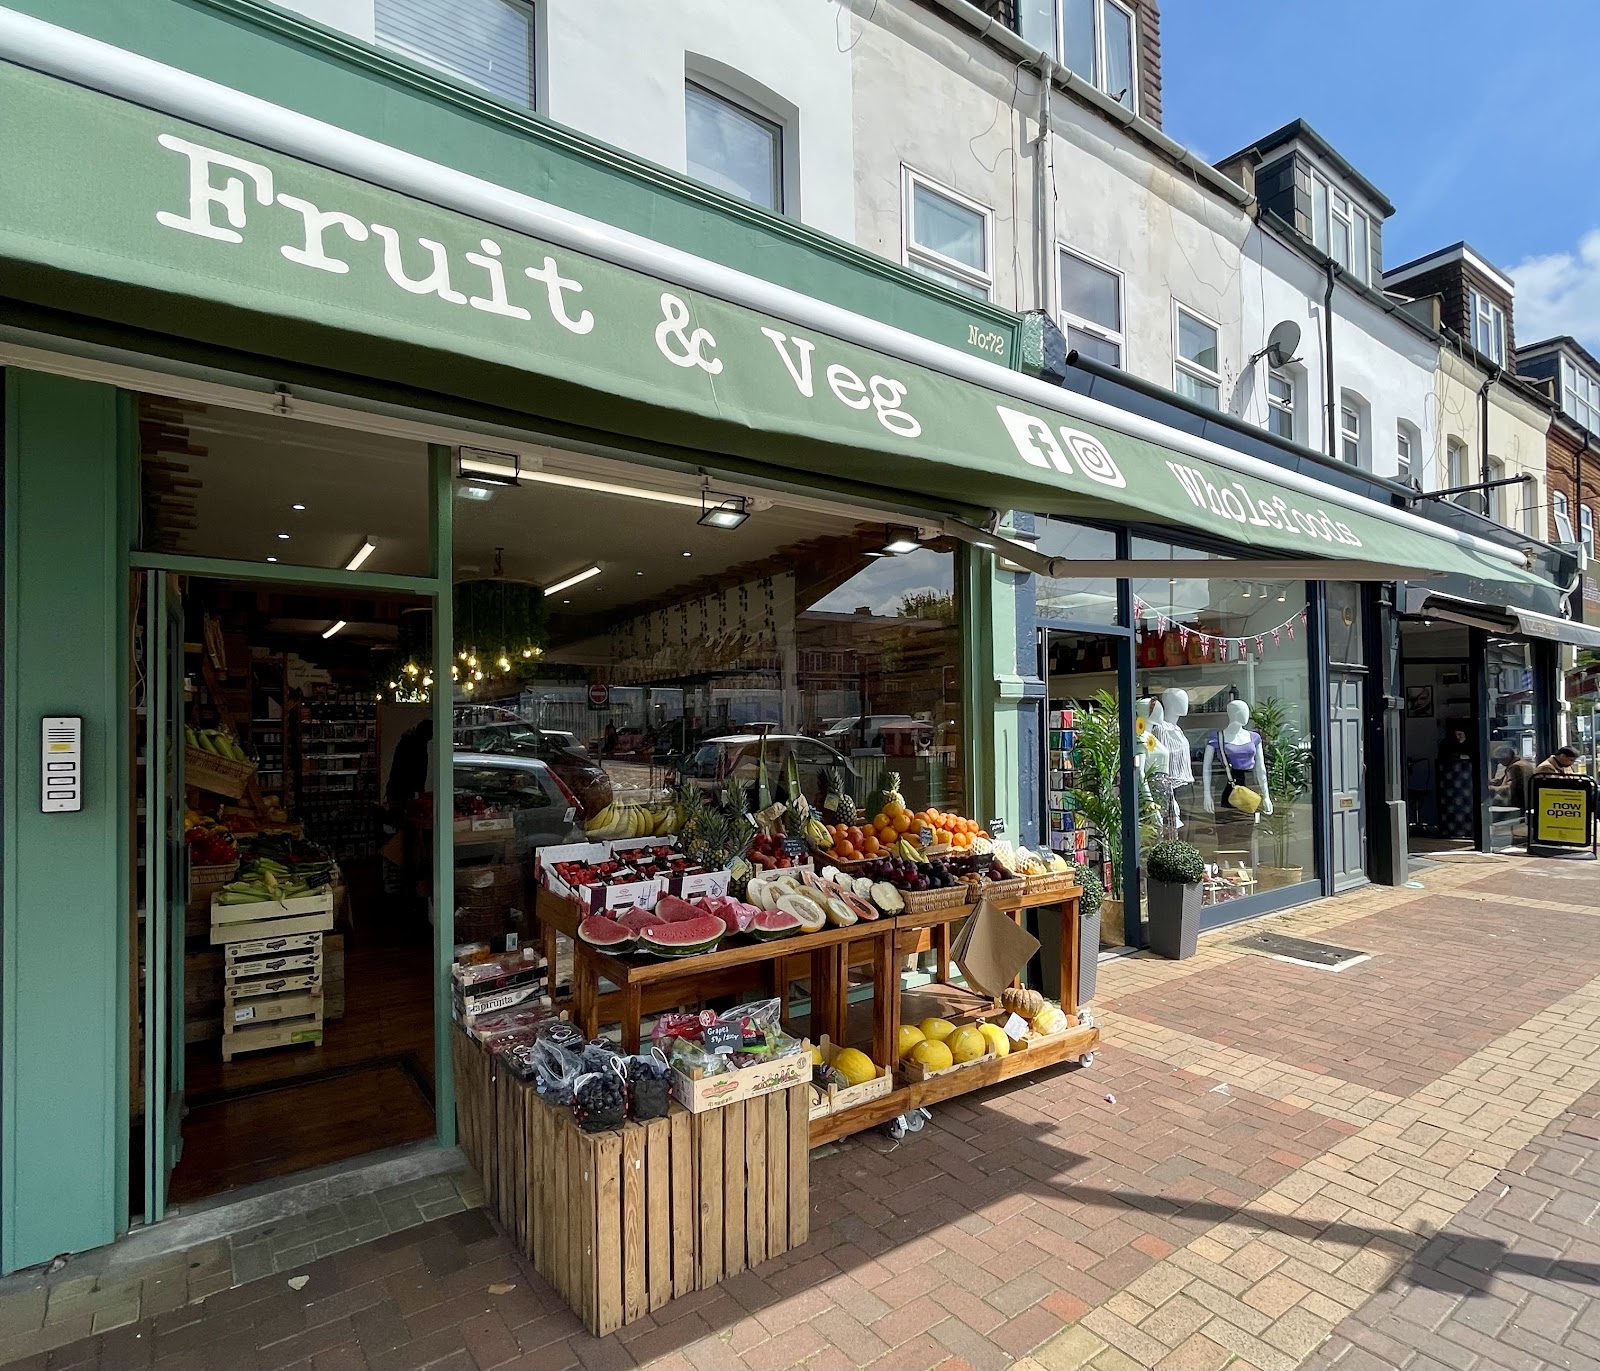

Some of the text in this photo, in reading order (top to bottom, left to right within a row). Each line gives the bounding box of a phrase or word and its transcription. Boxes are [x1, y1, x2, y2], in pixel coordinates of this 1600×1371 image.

[156, 133, 922, 438] Fruit & Veg
[1165, 460, 1363, 548] Wholefoods
[1546, 809, 1581, 818] open
[1553, 802, 1581, 810] now
